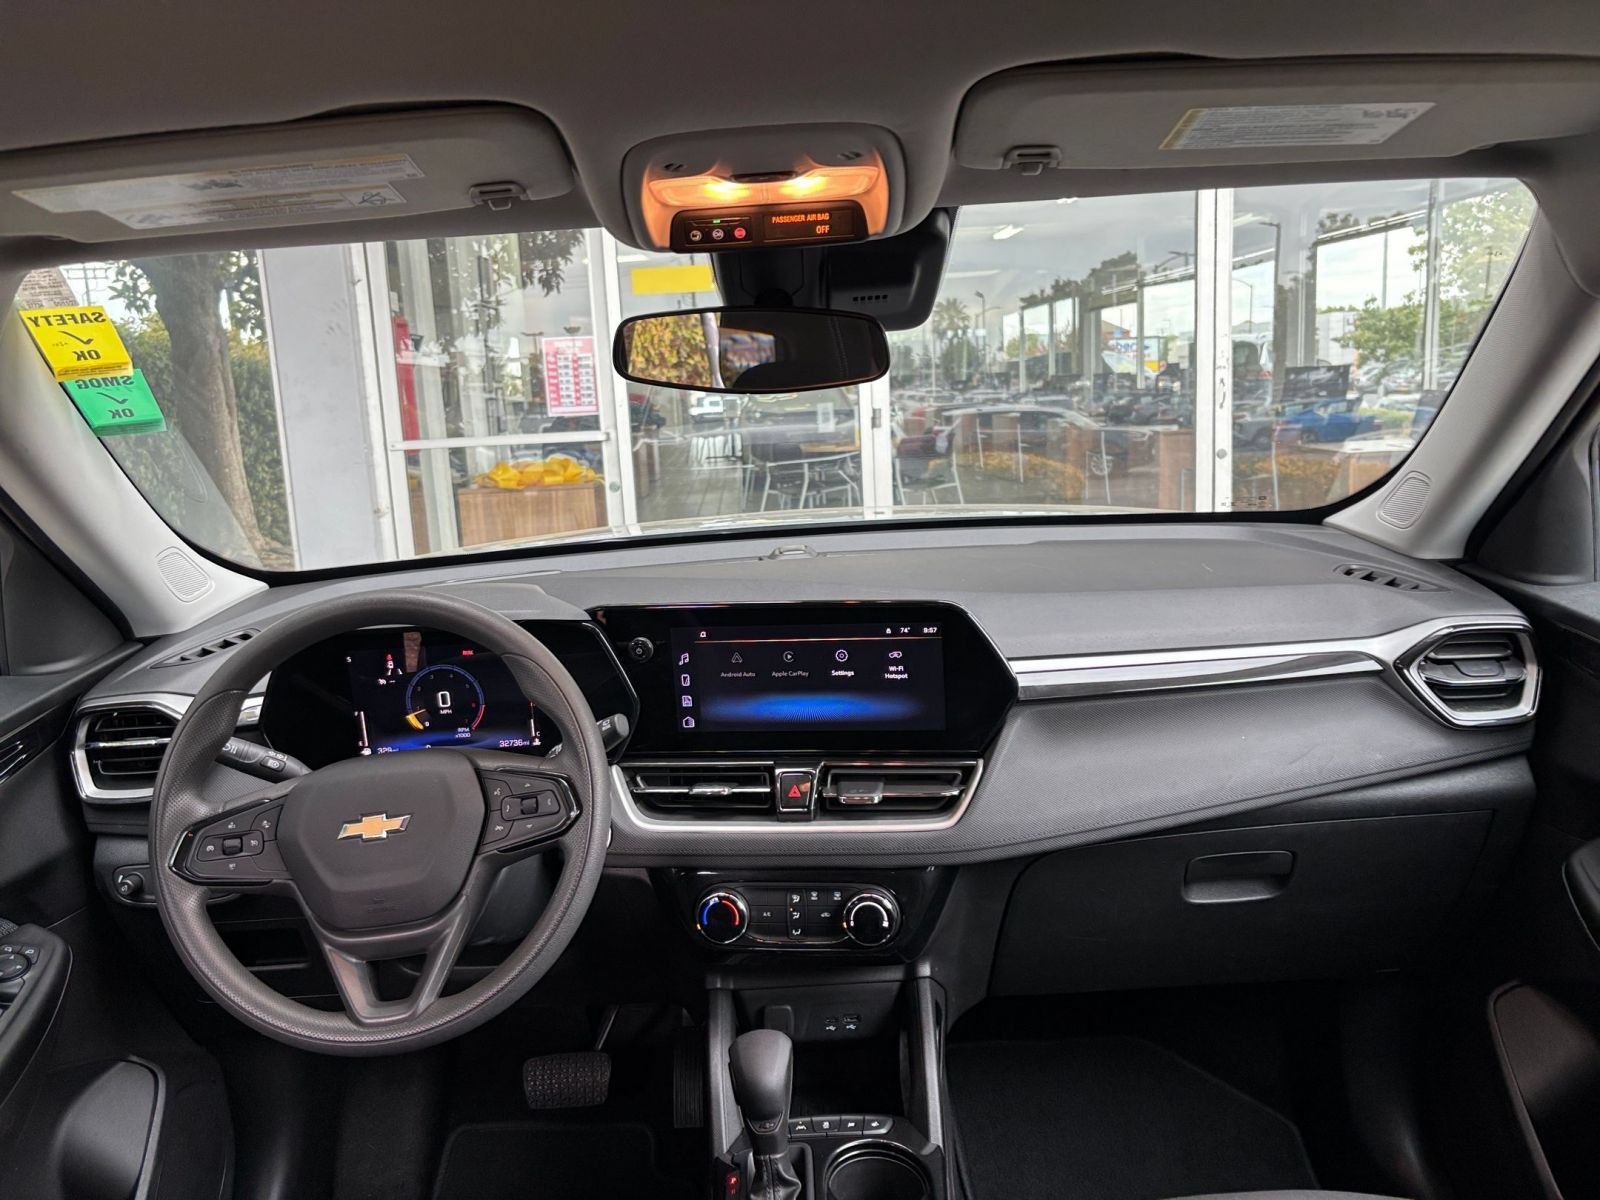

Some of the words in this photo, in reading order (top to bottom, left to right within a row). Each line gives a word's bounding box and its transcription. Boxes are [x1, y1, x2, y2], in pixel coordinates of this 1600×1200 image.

[772, 214, 805, 224] PASSENGER
[807, 213, 817, 222] AIR
[817, 211, 830, 221] BAG
[816, 225, 830, 234] OFF
[788, 670, 809, 678] CarPlay
[437, 691, 451, 708] 0
